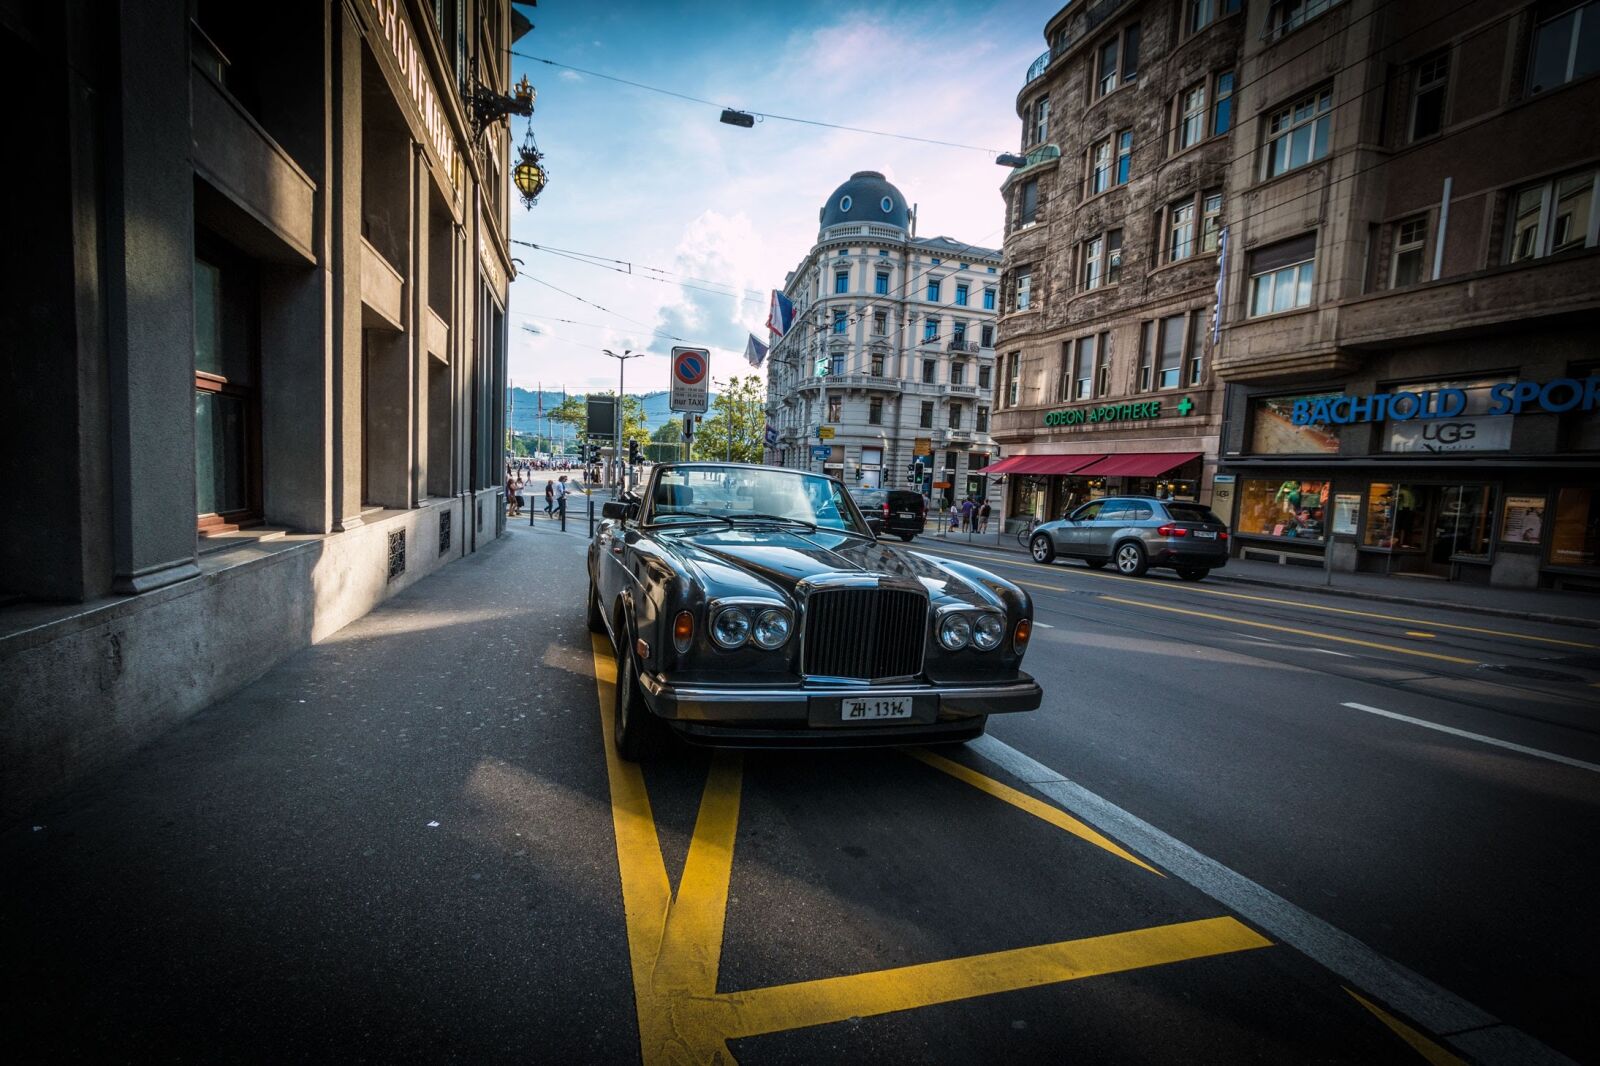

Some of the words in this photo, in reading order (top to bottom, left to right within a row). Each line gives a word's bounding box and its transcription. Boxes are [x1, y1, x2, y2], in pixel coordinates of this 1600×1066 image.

[674, 398, 686, 406] nur
[688, 398, 705, 406] TAXI
[1044, 409, 1086, 427] ODEON
[1088, 401, 1162, 424] APOTHEKE
[1423, 422, 1476, 444] UGG
